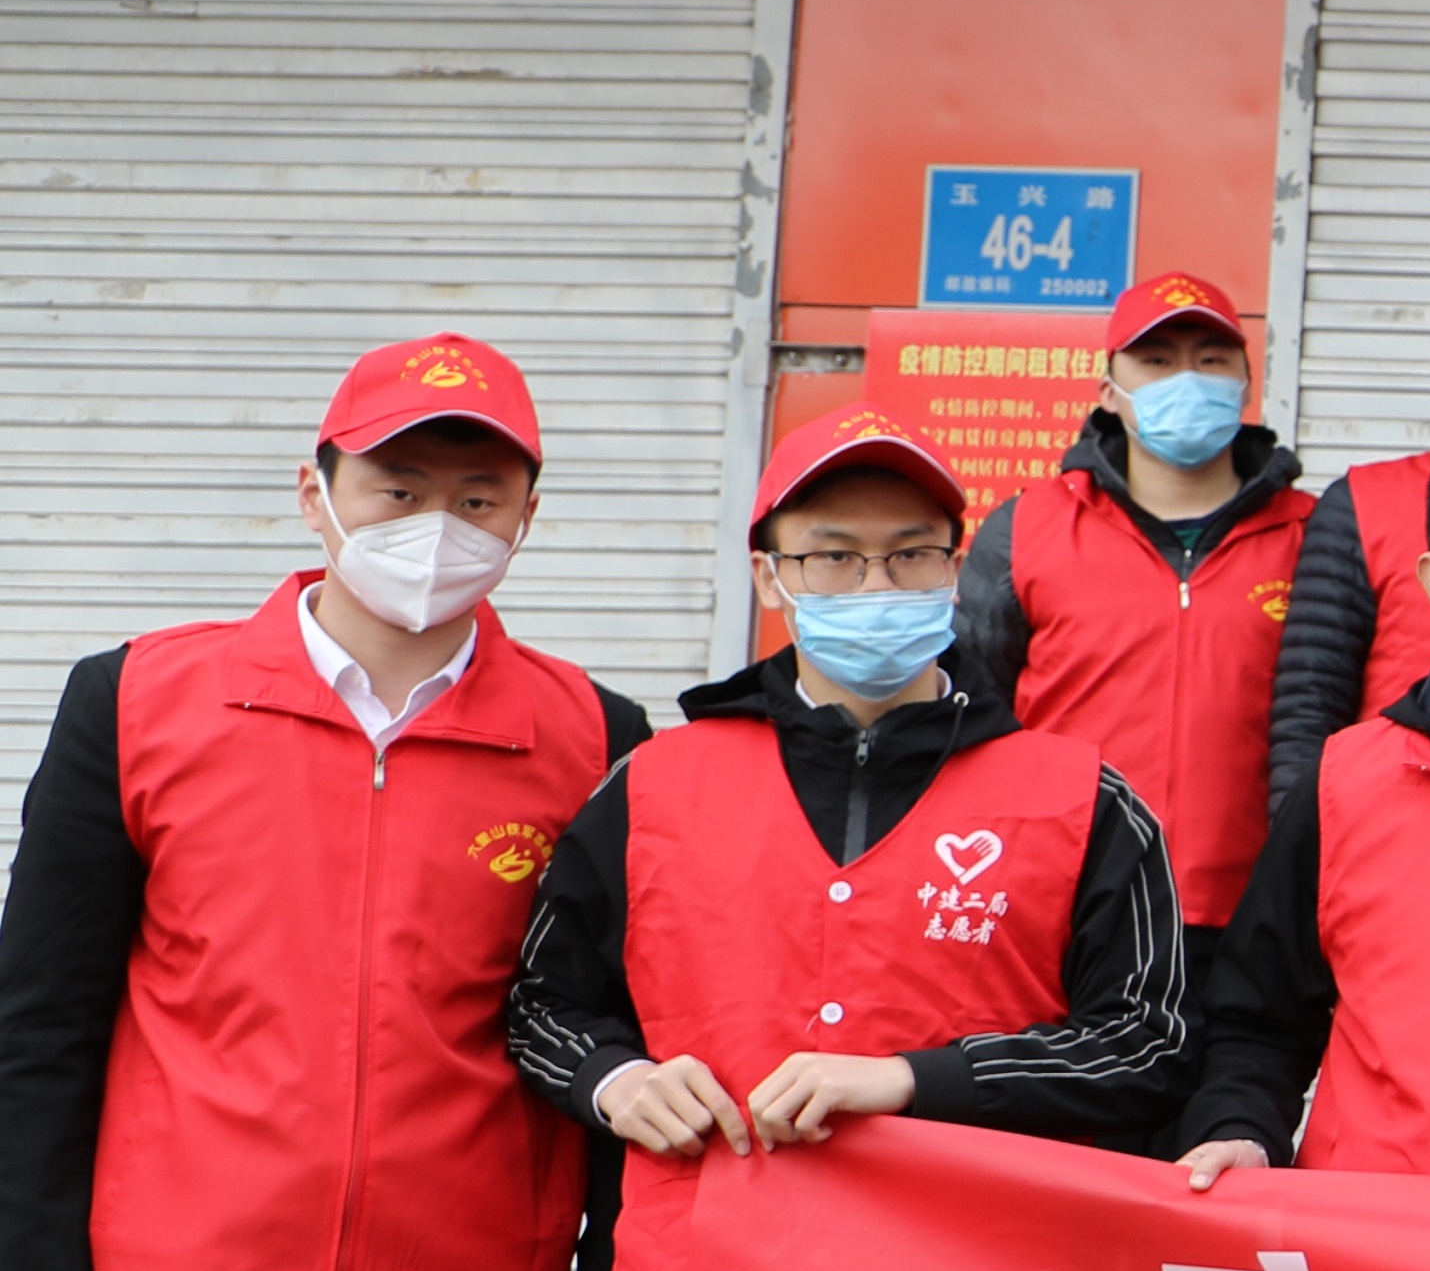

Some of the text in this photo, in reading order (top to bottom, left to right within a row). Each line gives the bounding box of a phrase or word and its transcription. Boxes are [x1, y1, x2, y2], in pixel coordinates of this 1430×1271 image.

[950, 183, 1116, 210] 玉兴路
[980, 213, 1074, 272] 46-4
[1040, 278, 1109, 297] 250002
[917, 882, 1010, 916] 中建二局
